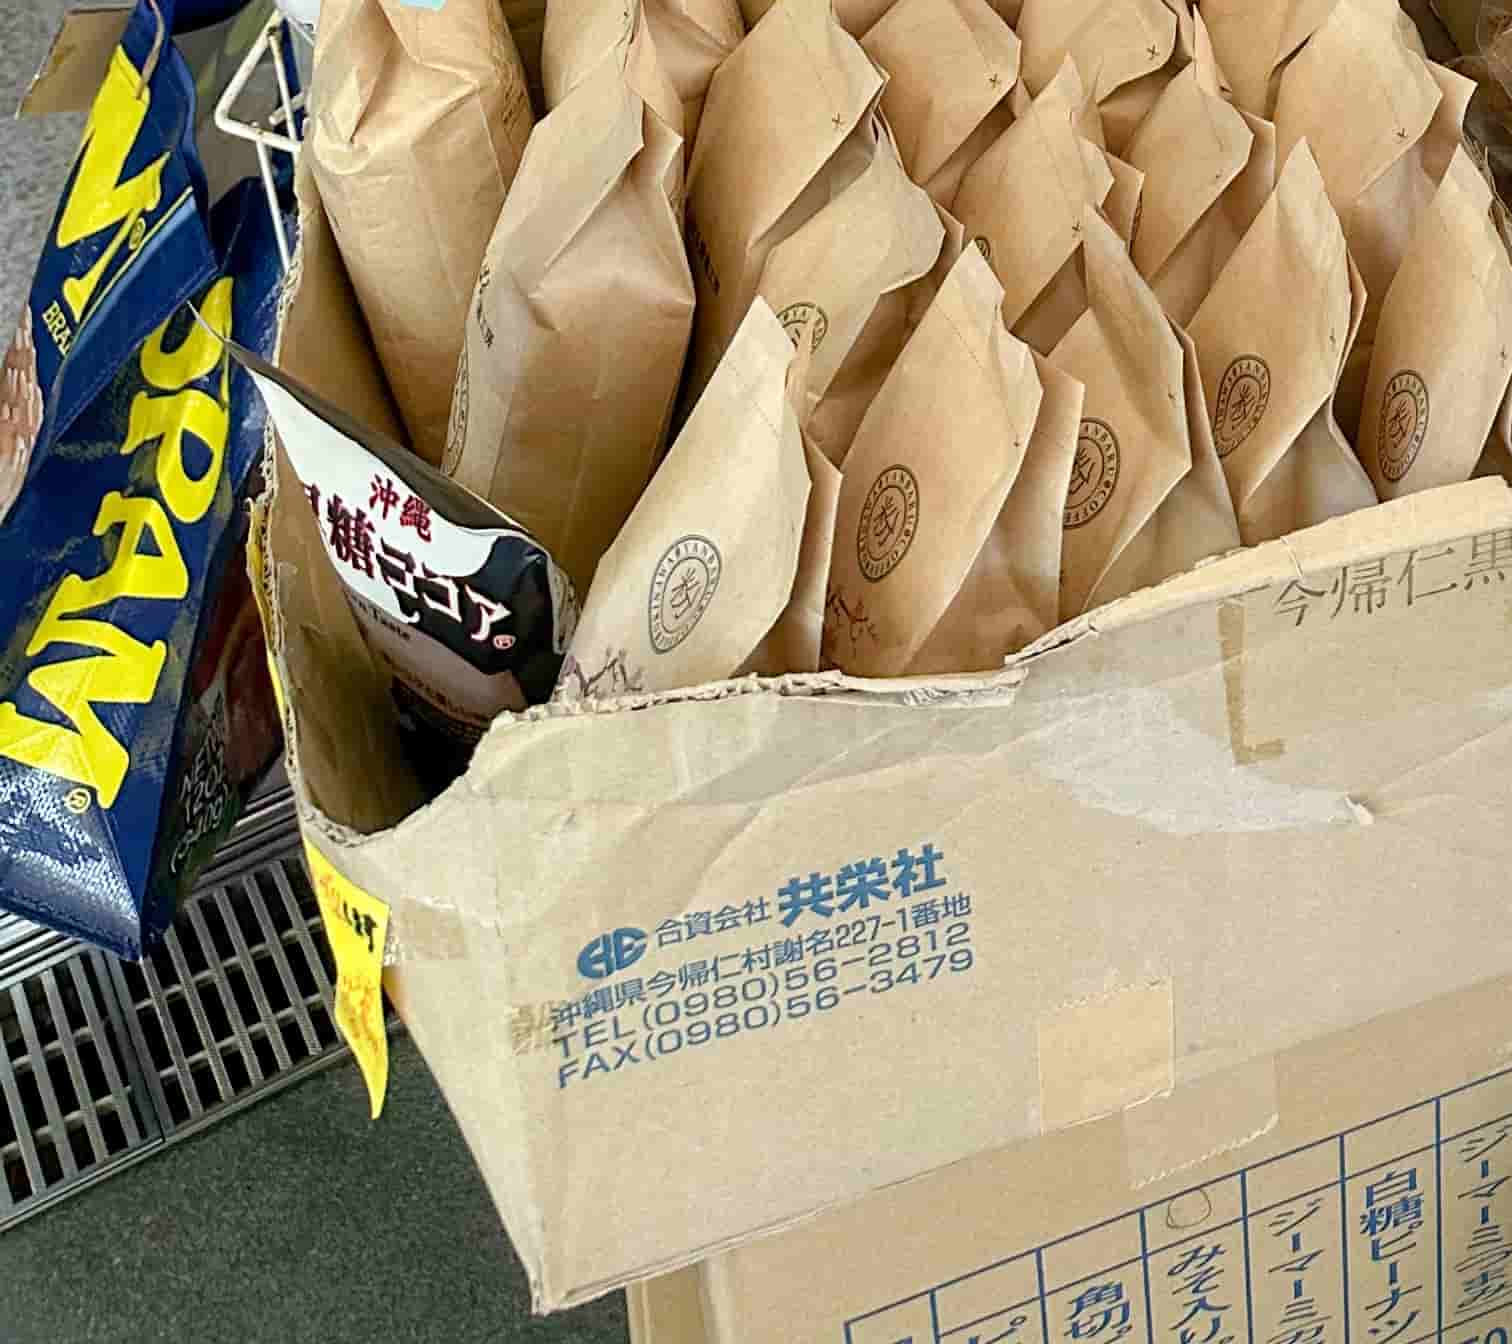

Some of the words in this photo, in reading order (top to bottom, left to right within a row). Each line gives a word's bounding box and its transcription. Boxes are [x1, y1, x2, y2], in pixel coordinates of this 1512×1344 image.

[0, 274, 234, 811] SPAM
[655, 897, 773, 948] 合資会社
[777, 842, 948, 928] 共栄社
